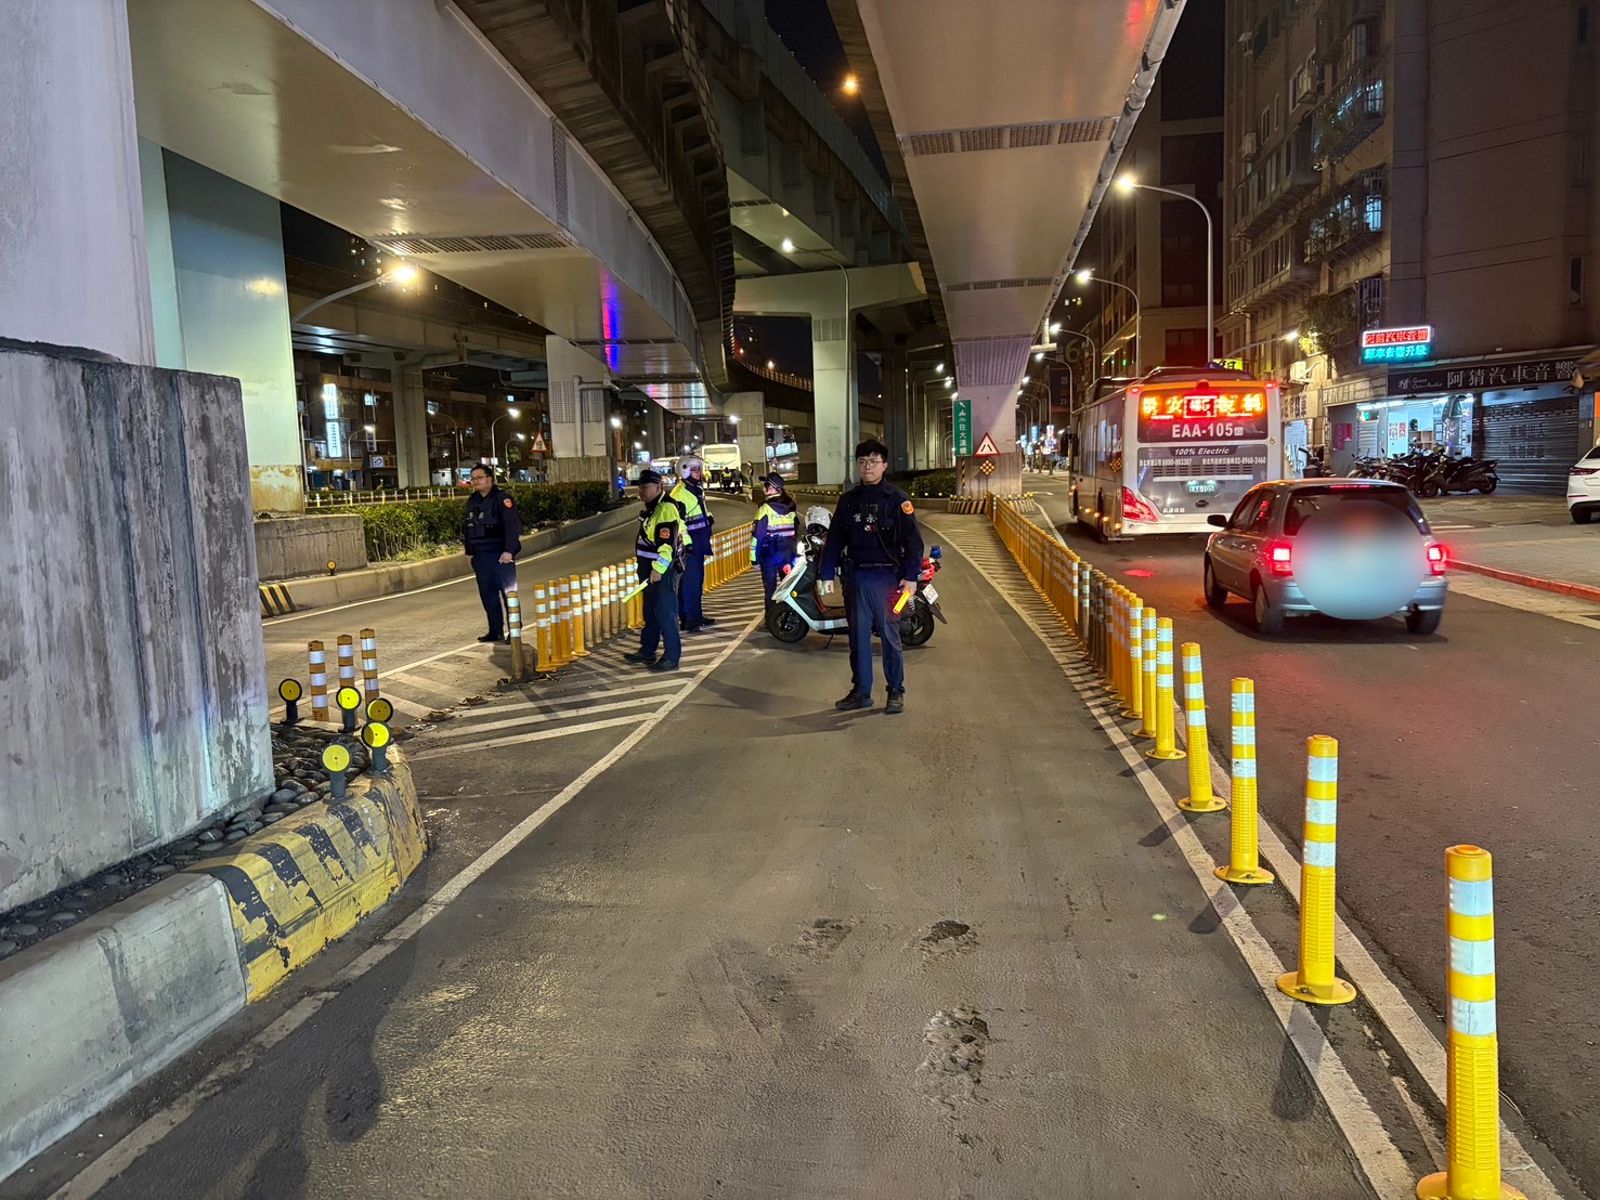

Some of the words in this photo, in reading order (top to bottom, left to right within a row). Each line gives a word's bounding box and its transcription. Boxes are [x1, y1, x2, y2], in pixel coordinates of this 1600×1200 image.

[1447, 361, 1577, 388] 阿猜汽車音響
[1172, 423, 1233, 438] EAA-105
[1175, 448, 1196, 456] 100%
[1198, 447, 1230, 455] Electric
